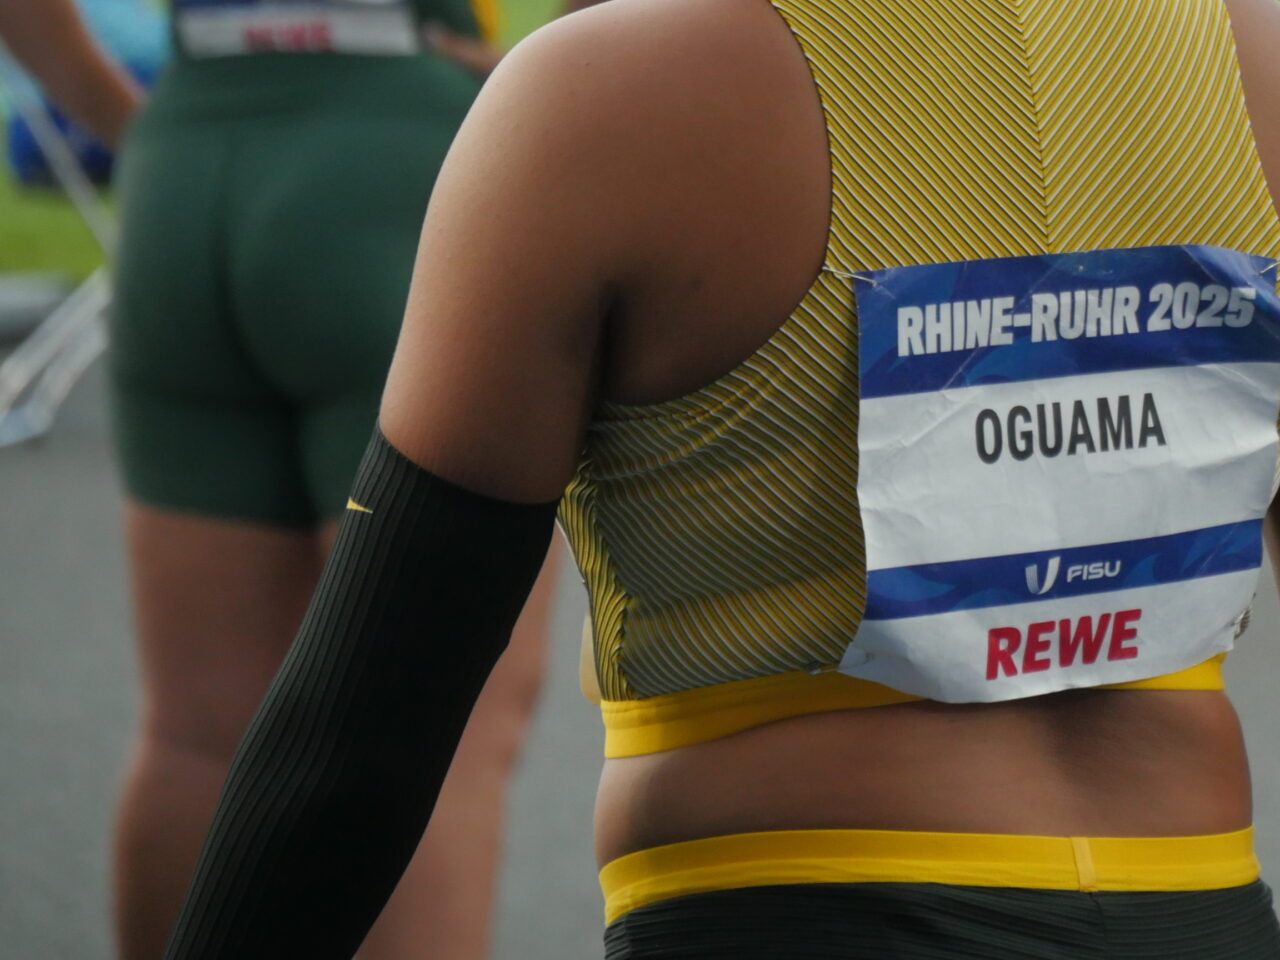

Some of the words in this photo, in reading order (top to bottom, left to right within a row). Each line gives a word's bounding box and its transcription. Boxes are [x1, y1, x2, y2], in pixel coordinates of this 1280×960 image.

[897, 286, 1140, 357] RHINE-RUHR
[1147, 282, 1257, 332] 2025
[974, 392, 1167, 465] OGUAMA
[1066, 560, 1121, 584] FISU
[984, 608, 1142, 681] REWE
